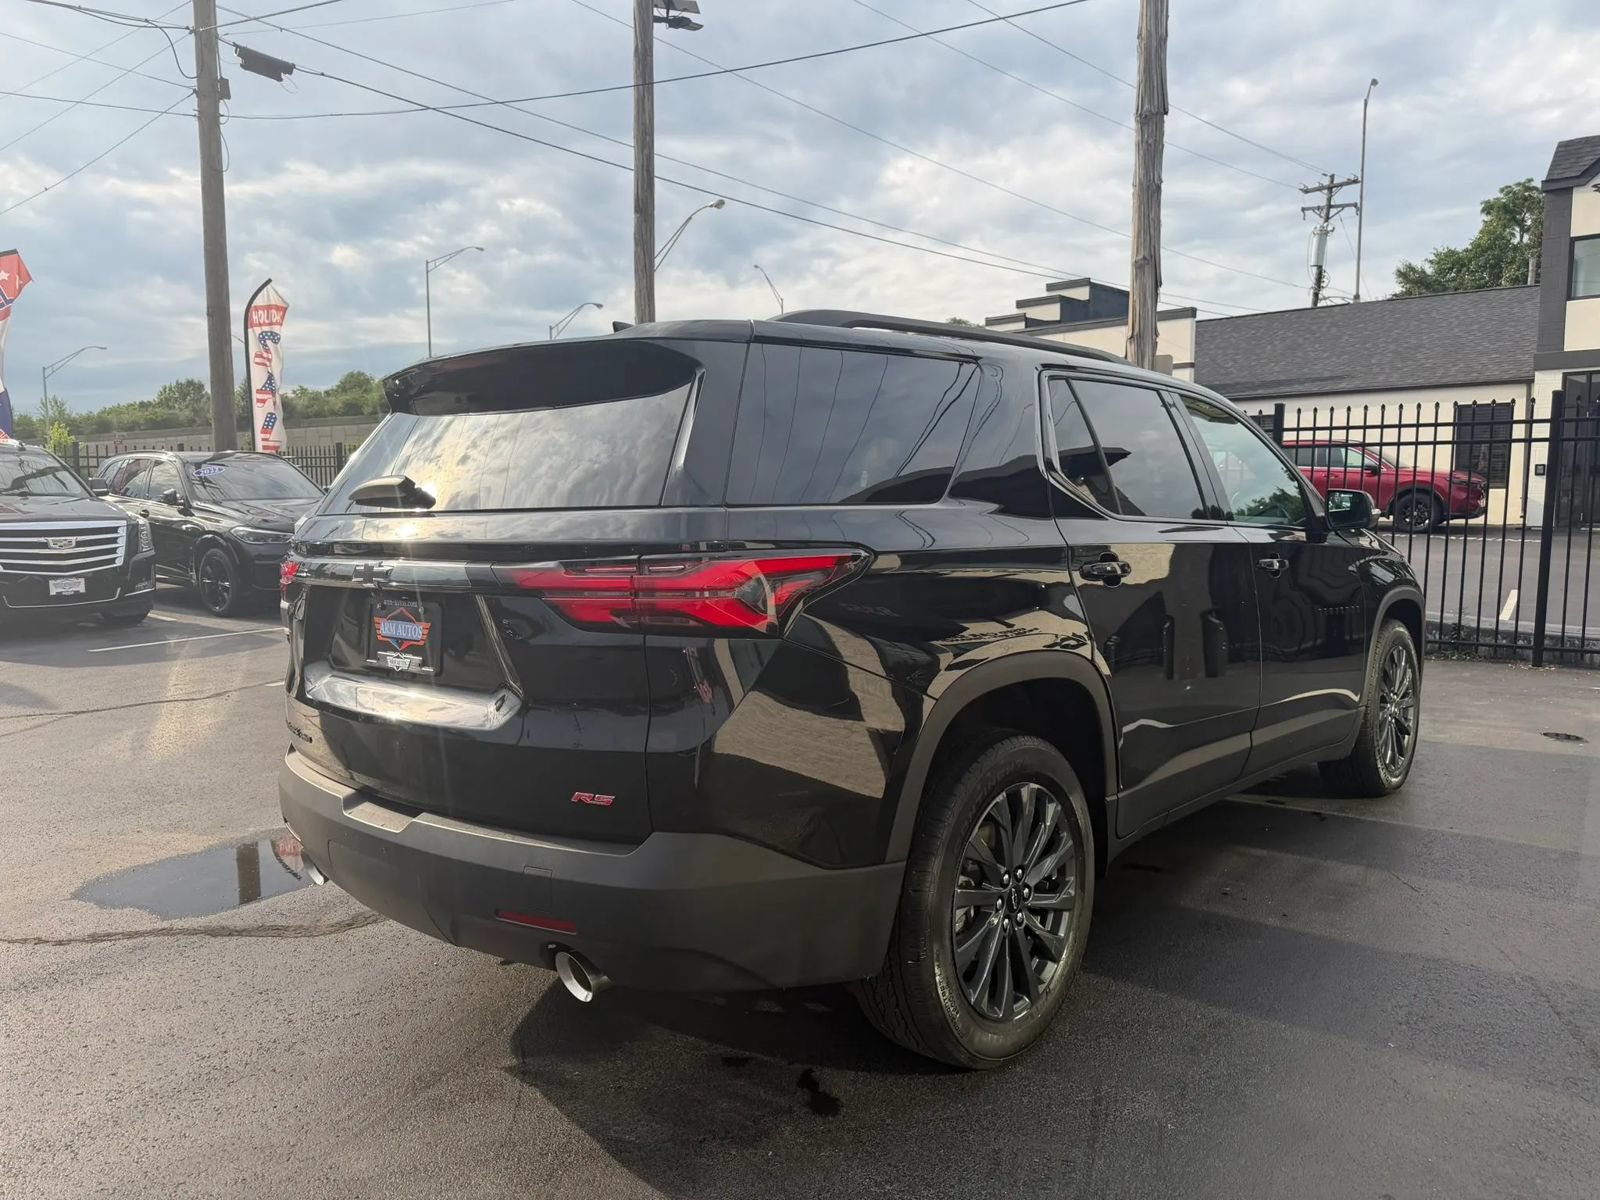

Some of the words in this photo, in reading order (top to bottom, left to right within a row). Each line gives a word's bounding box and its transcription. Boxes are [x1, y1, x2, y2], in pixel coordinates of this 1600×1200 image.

[252, 309, 283, 324] HOLIDA
[253, 330, 281, 454] SAL
[381, 622, 396, 635] ARM
[396, 624, 423, 638] AUTOS
[571, 791, 616, 806] RS
